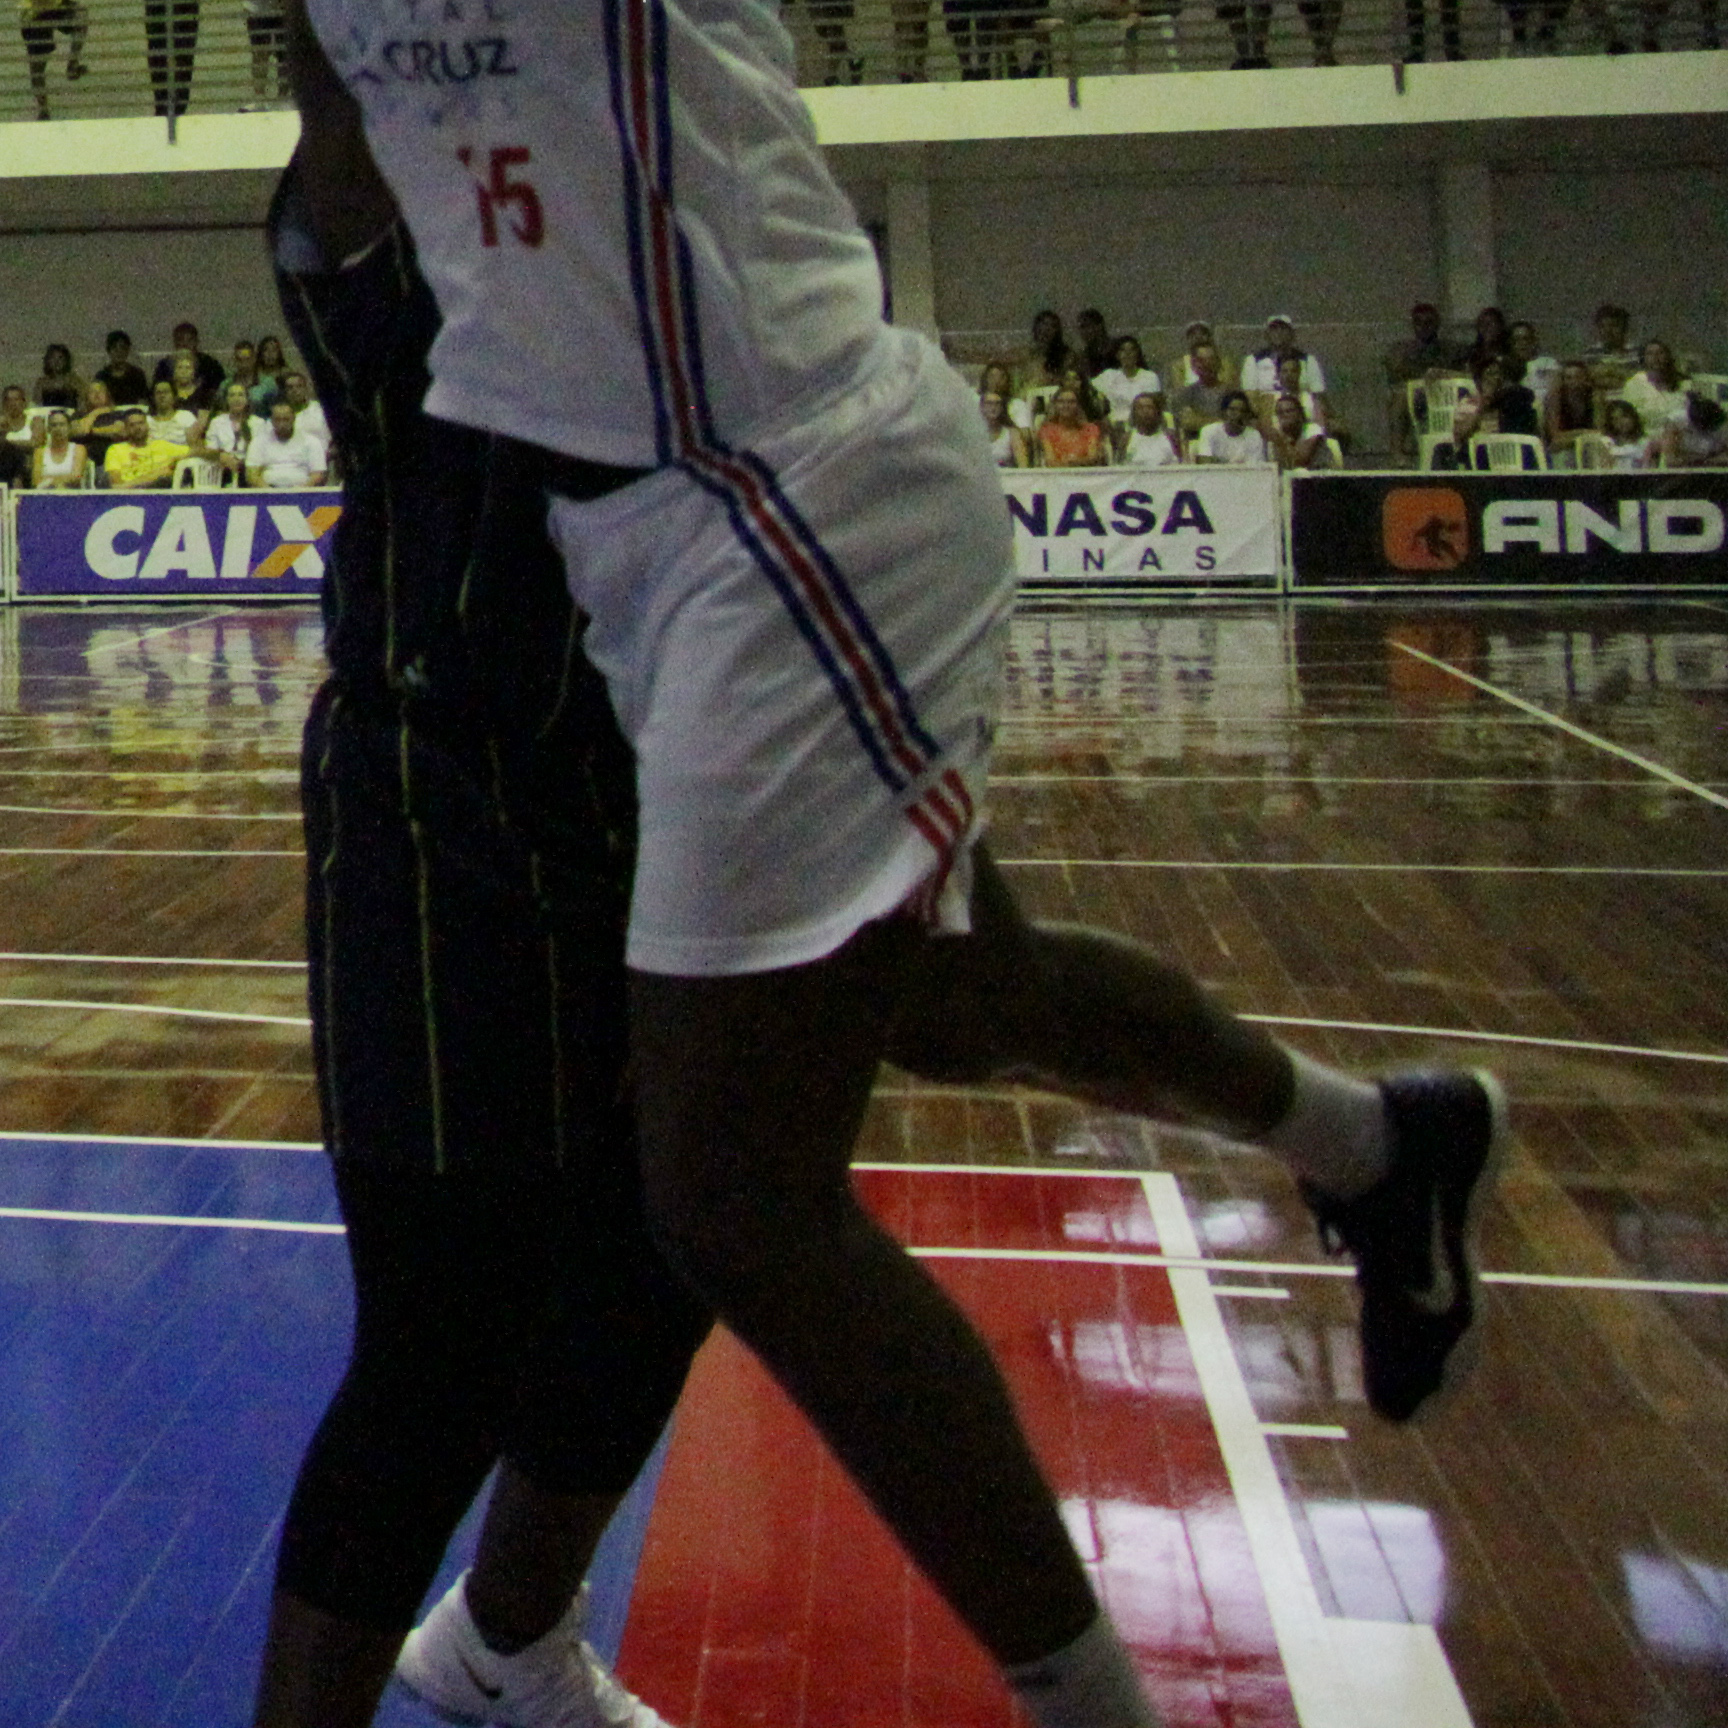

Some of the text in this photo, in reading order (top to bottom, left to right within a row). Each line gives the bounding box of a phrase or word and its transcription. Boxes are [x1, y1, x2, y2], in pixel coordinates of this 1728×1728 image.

[457, 146, 544, 248] 15
[83, 504, 343, 580] CAIX
[1005, 490, 1216, 537] NASA
[1482, 499, 1725, 553] AND
